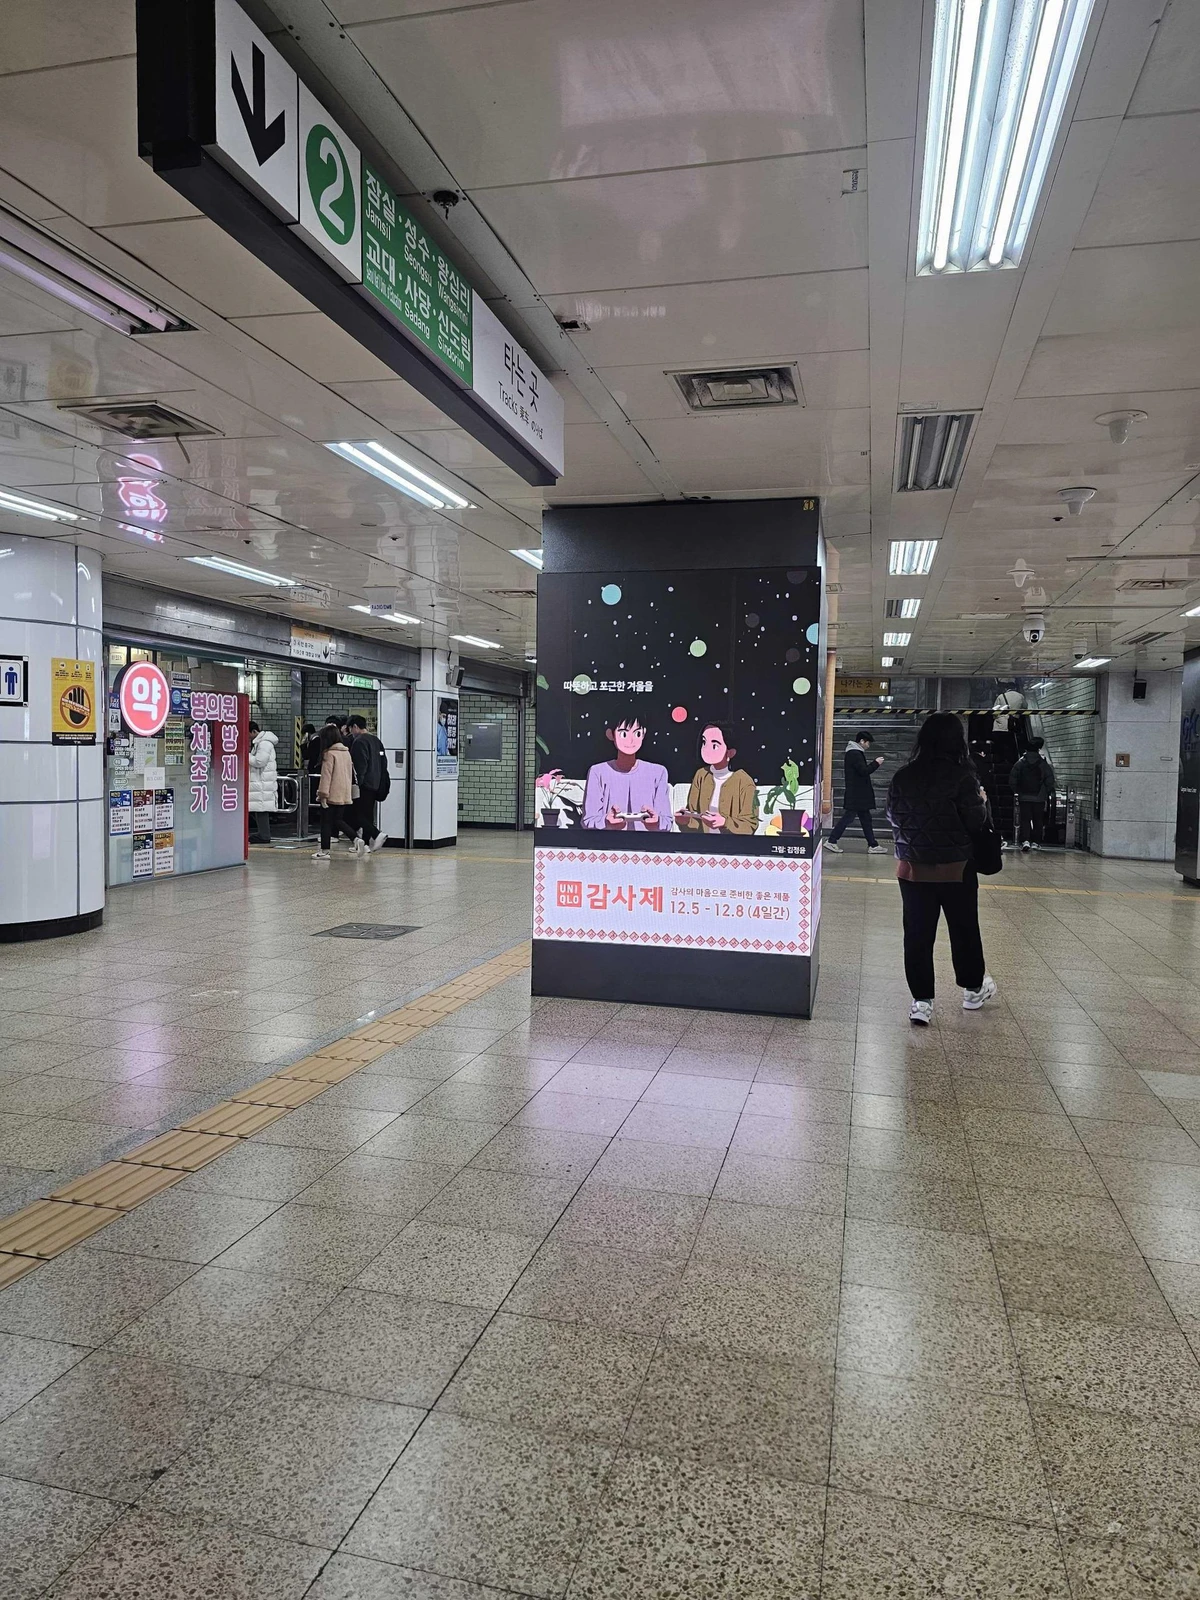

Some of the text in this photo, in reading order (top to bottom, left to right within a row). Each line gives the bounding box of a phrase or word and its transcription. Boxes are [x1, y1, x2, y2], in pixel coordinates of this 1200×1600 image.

[319, 136, 346, 236] 2
[365, 202, 390, 241] Jamsil
[404, 244, 433, 287] Seongsu
[404, 302, 431, 339] Sadang
[437, 335, 465, 372] Sindorim
[504, 342, 540, 413] 타는 곳
[498, 380, 518, 416] Tracks
[131, 676, 162, 721] 약
[563, 680, 654, 693] 따뜻하고 포근한 겨울을
[840, 679, 874, 689] 나가는 곳
[190, 692, 238, 722] 병의원
[559, 883, 579, 894] UNI
[559, 894, 580, 905] QLO
[586, 883, 664, 913] 감사제
[671, 887, 791, 902] 감사의 마음으로 준비한 좋은 제품
[670, 900, 700, 915] 12.5
[715, 903, 744, 918] 12.8
[747, 905, 791, 921] (4일간)
